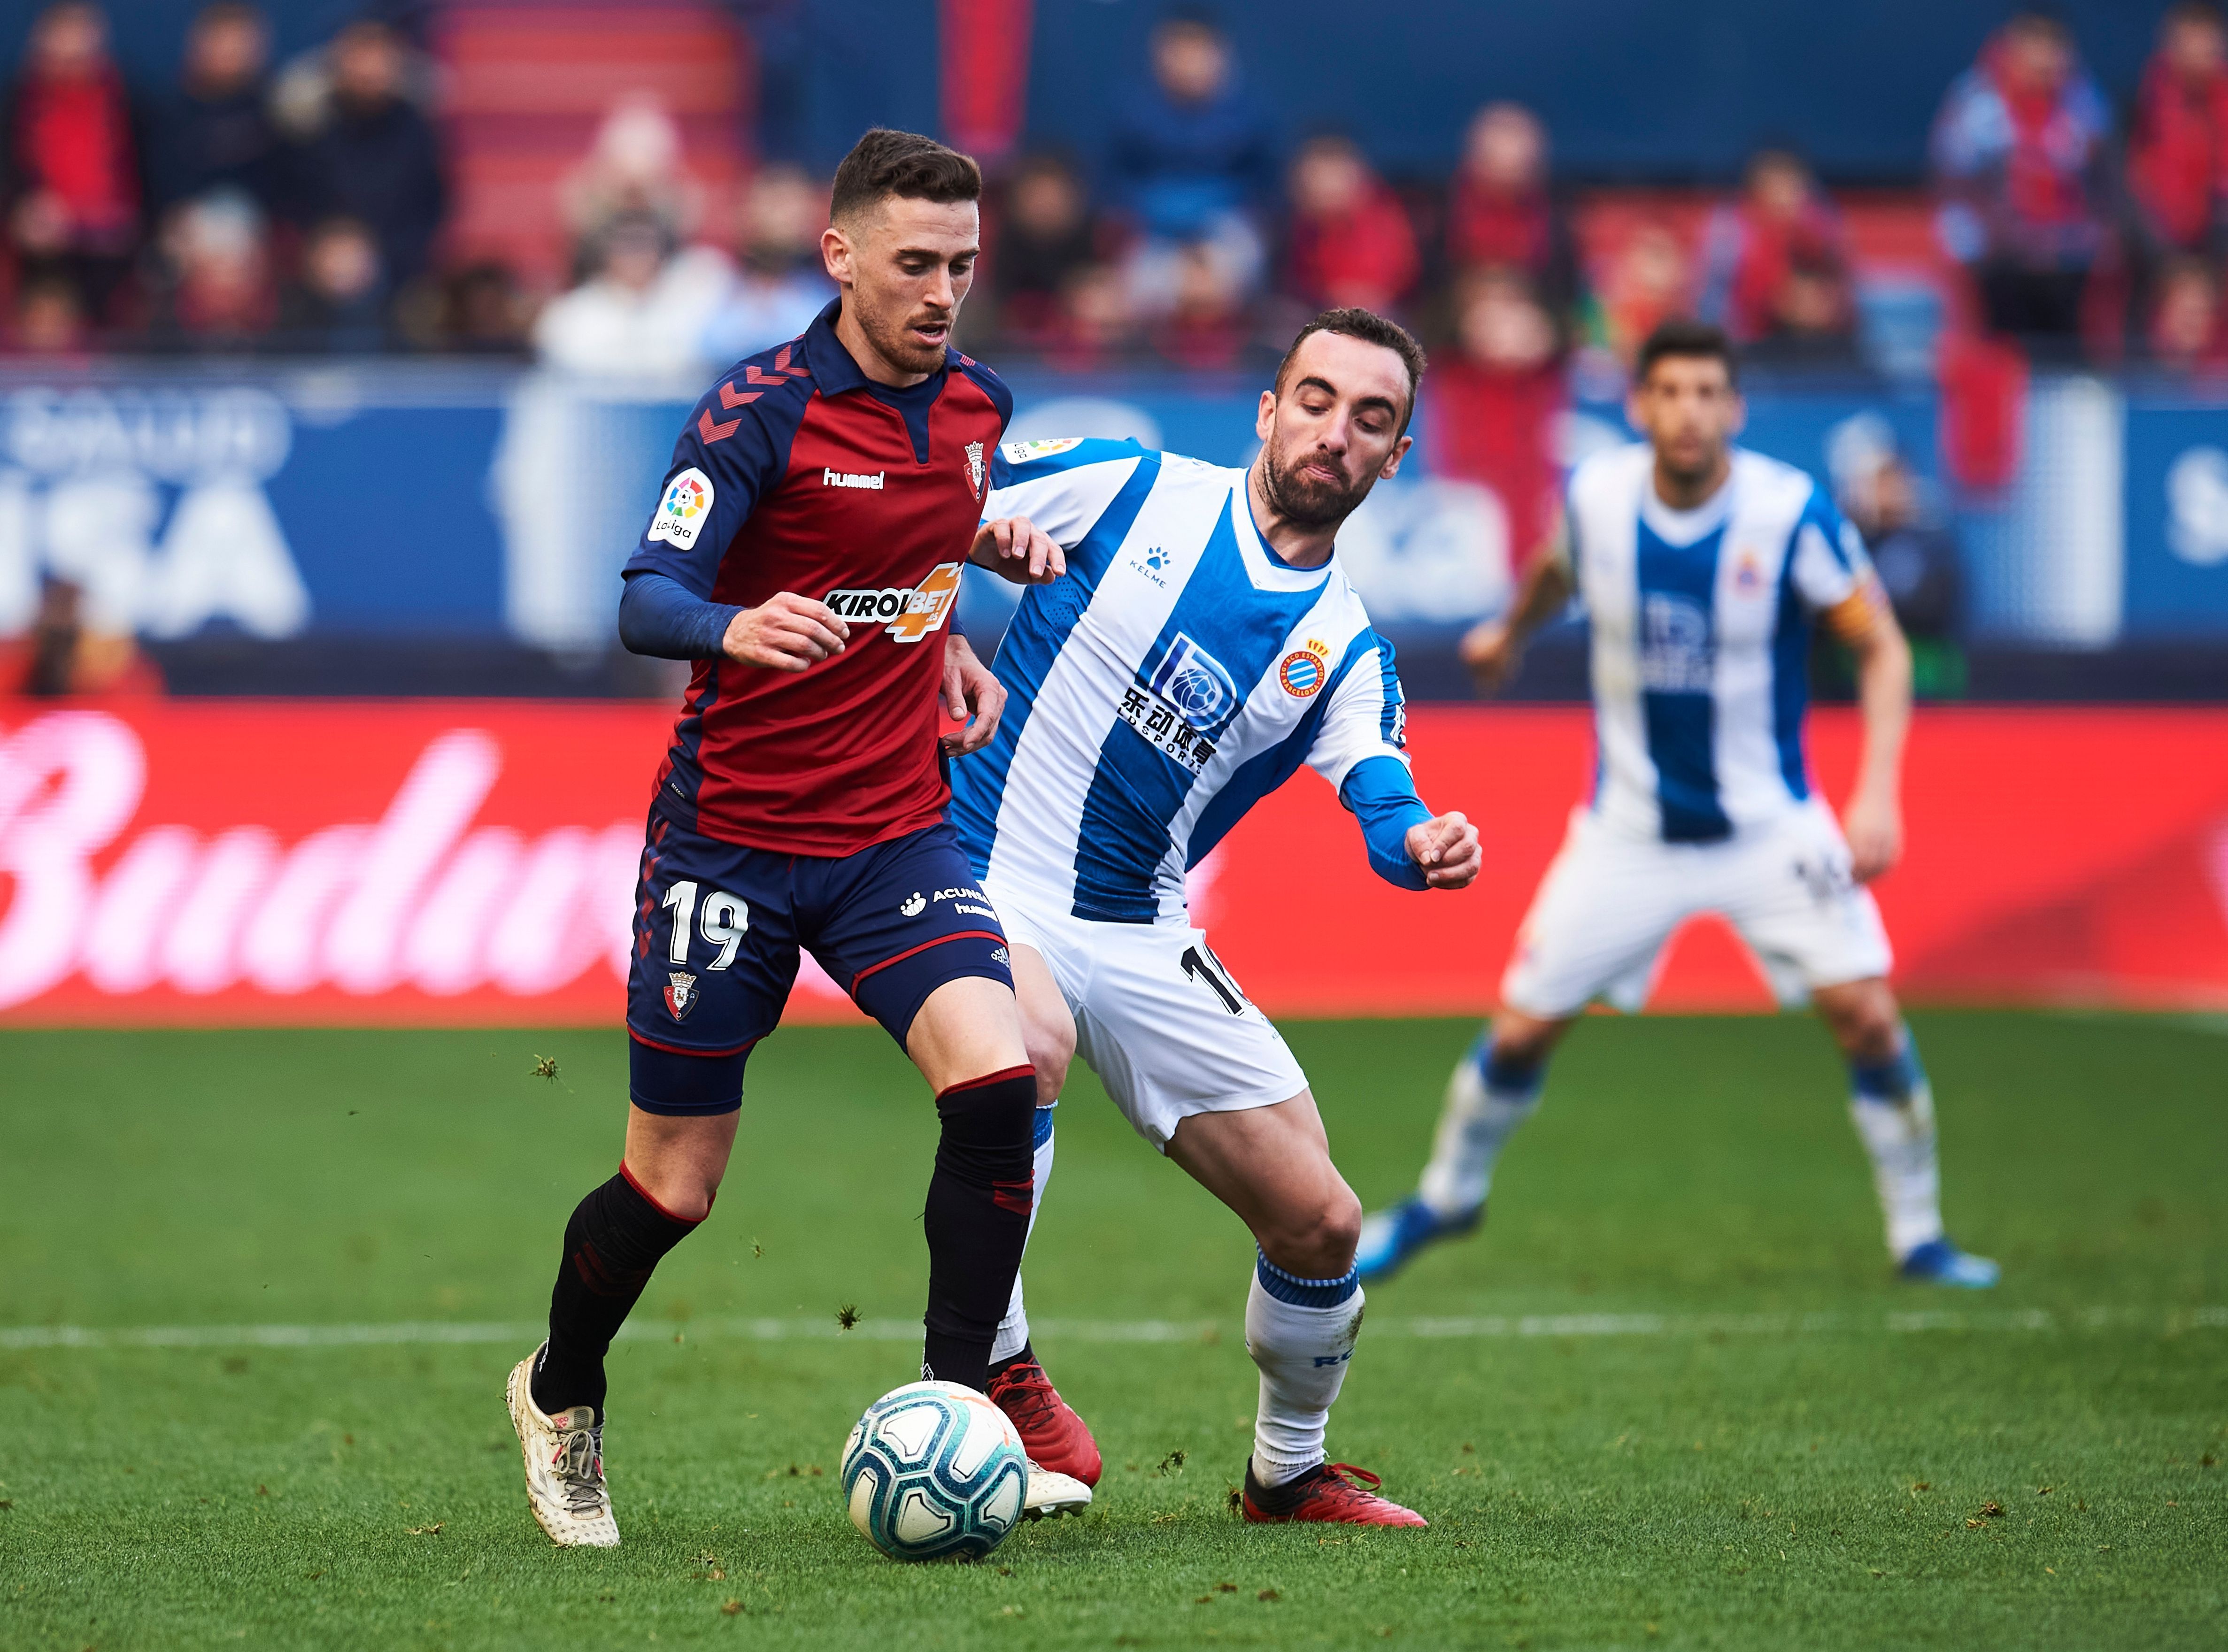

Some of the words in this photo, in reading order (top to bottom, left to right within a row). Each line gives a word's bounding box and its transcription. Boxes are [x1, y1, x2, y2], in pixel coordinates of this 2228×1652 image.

[1014, 443, 1027, 459] Liga
[824, 468, 884, 490] hummel
[656, 520, 691, 538] LaLiga
[1130, 560, 1167, 589] KELME
[1121, 687, 1217, 765] 乐动体育
[663, 880, 748, 971] 19
